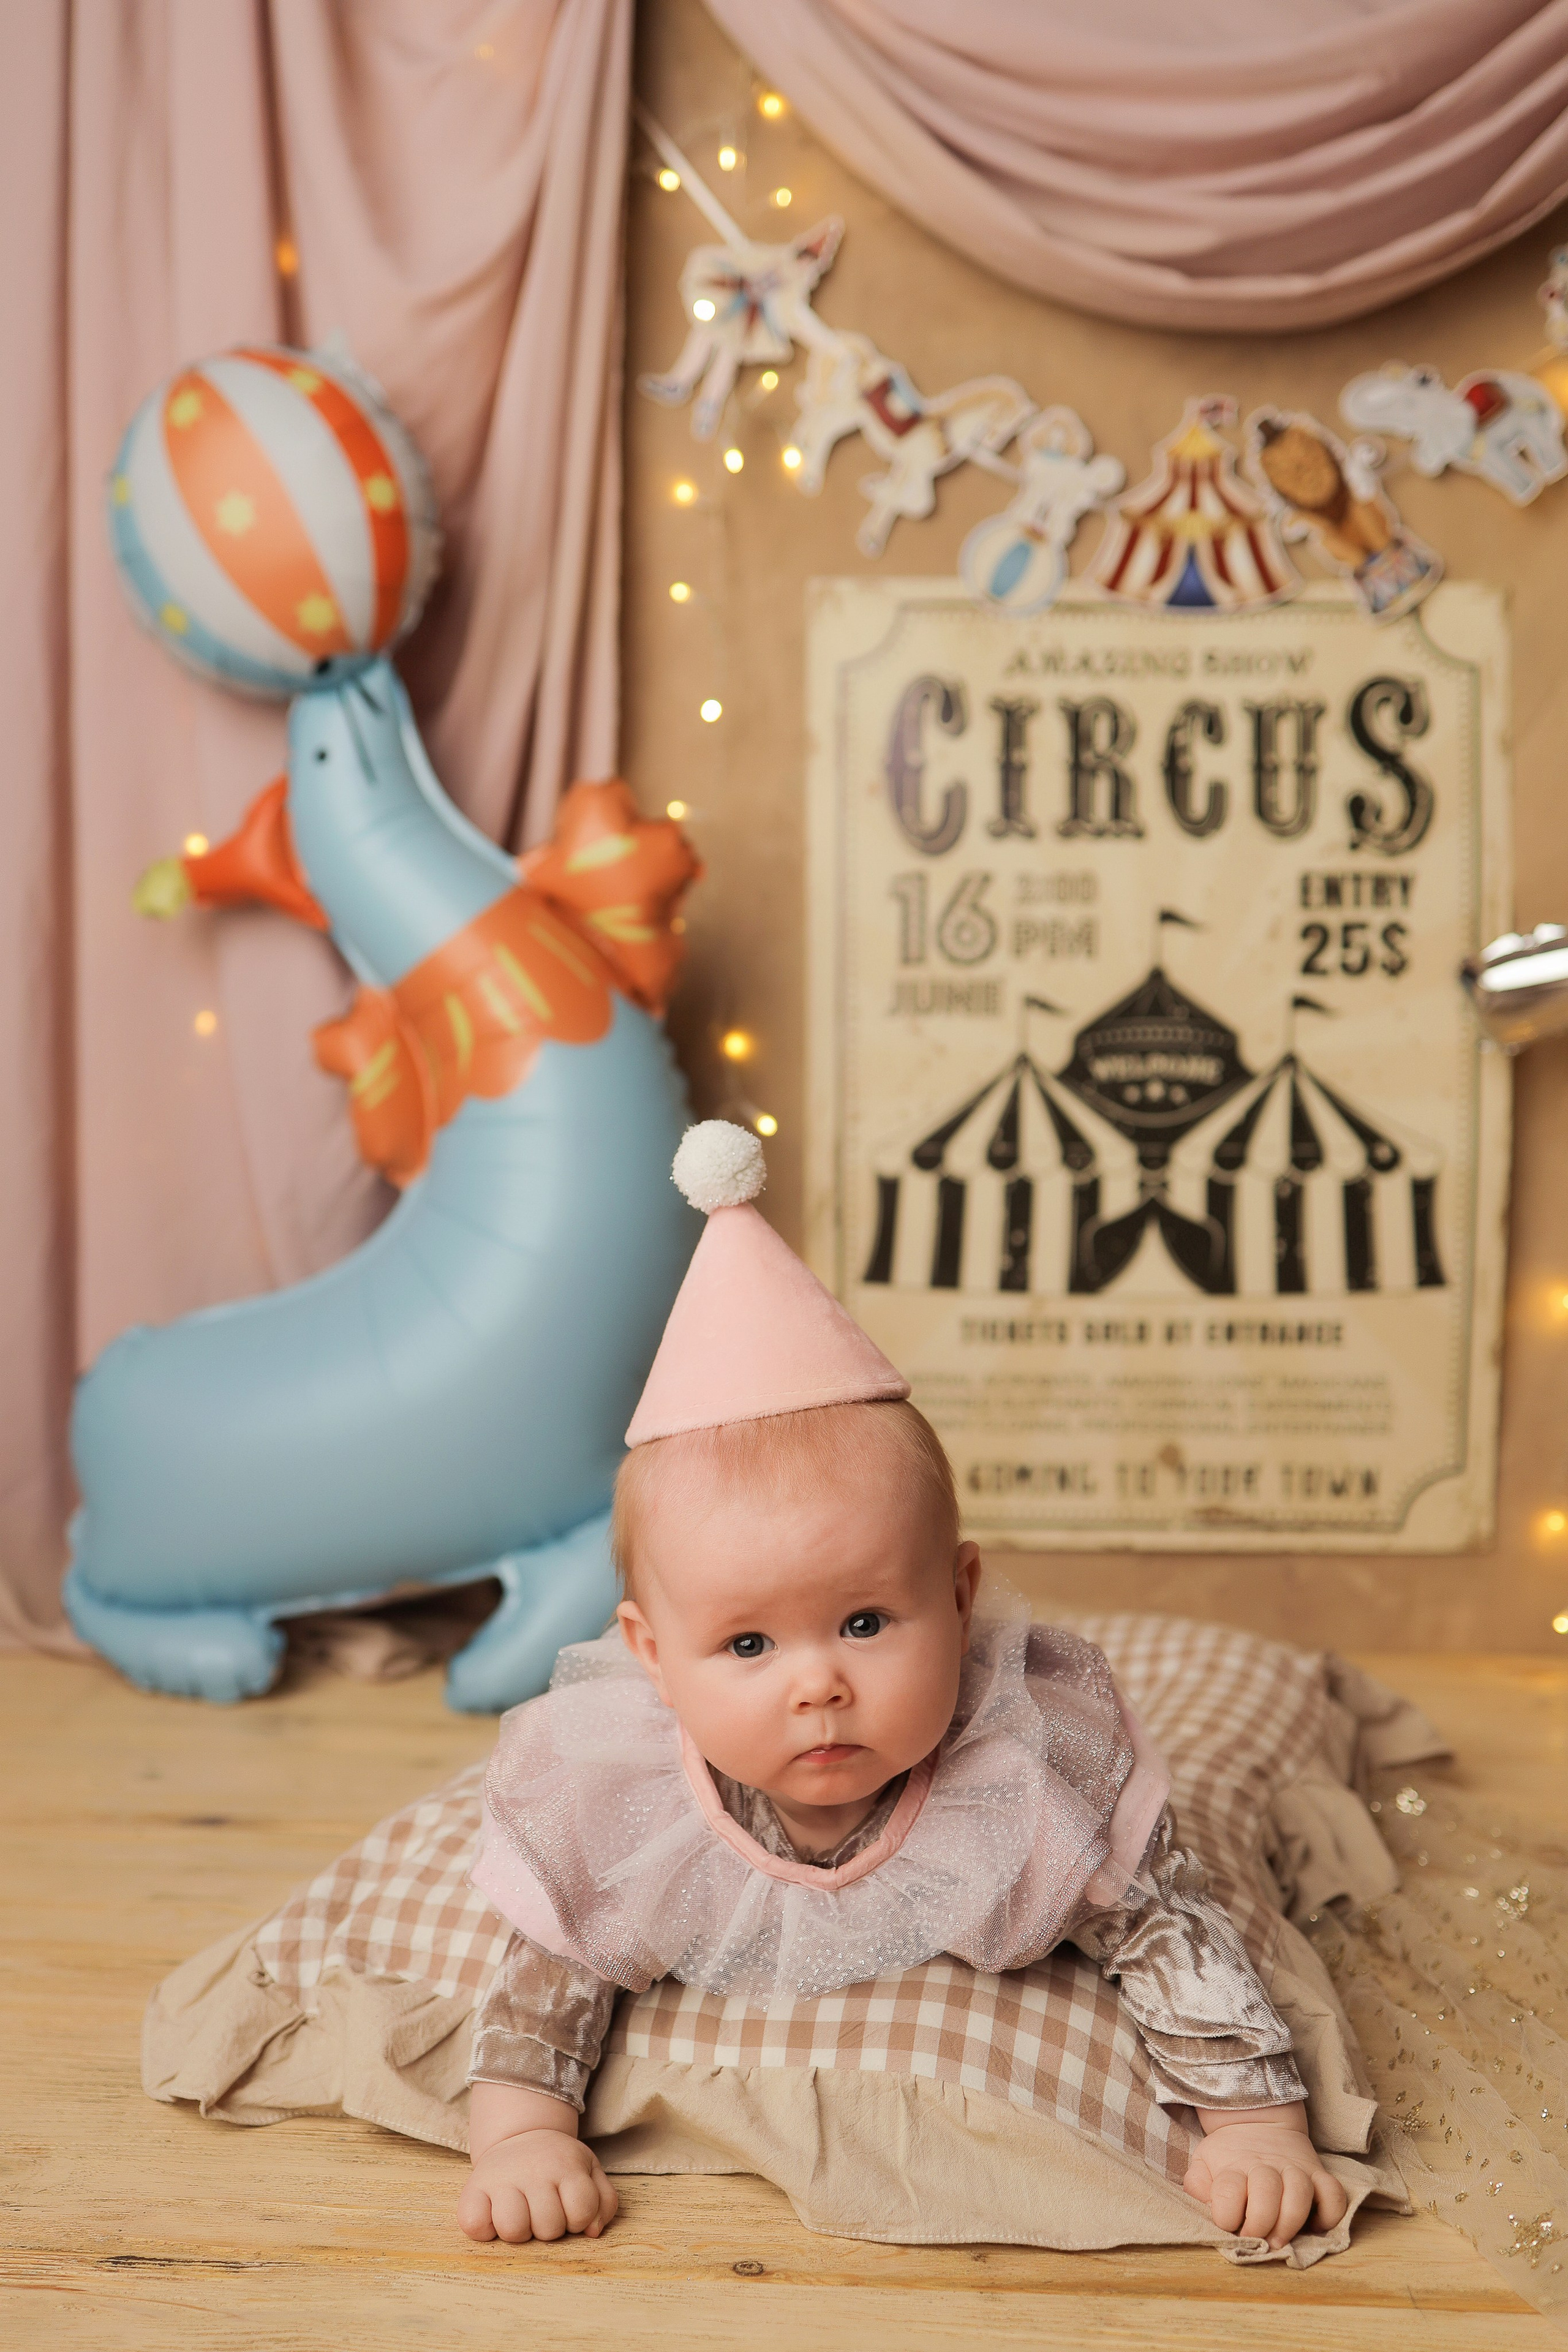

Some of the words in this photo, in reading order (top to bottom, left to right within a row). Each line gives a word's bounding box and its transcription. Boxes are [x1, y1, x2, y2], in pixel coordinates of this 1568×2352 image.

[885, 674, 1435, 856] CIRCUS
[1299, 871, 1415, 910] ENTRY
[888, 869, 997, 968] 16
[1012, 918, 1099, 959] PM
[888, 980, 1003, 1017] JUNE
